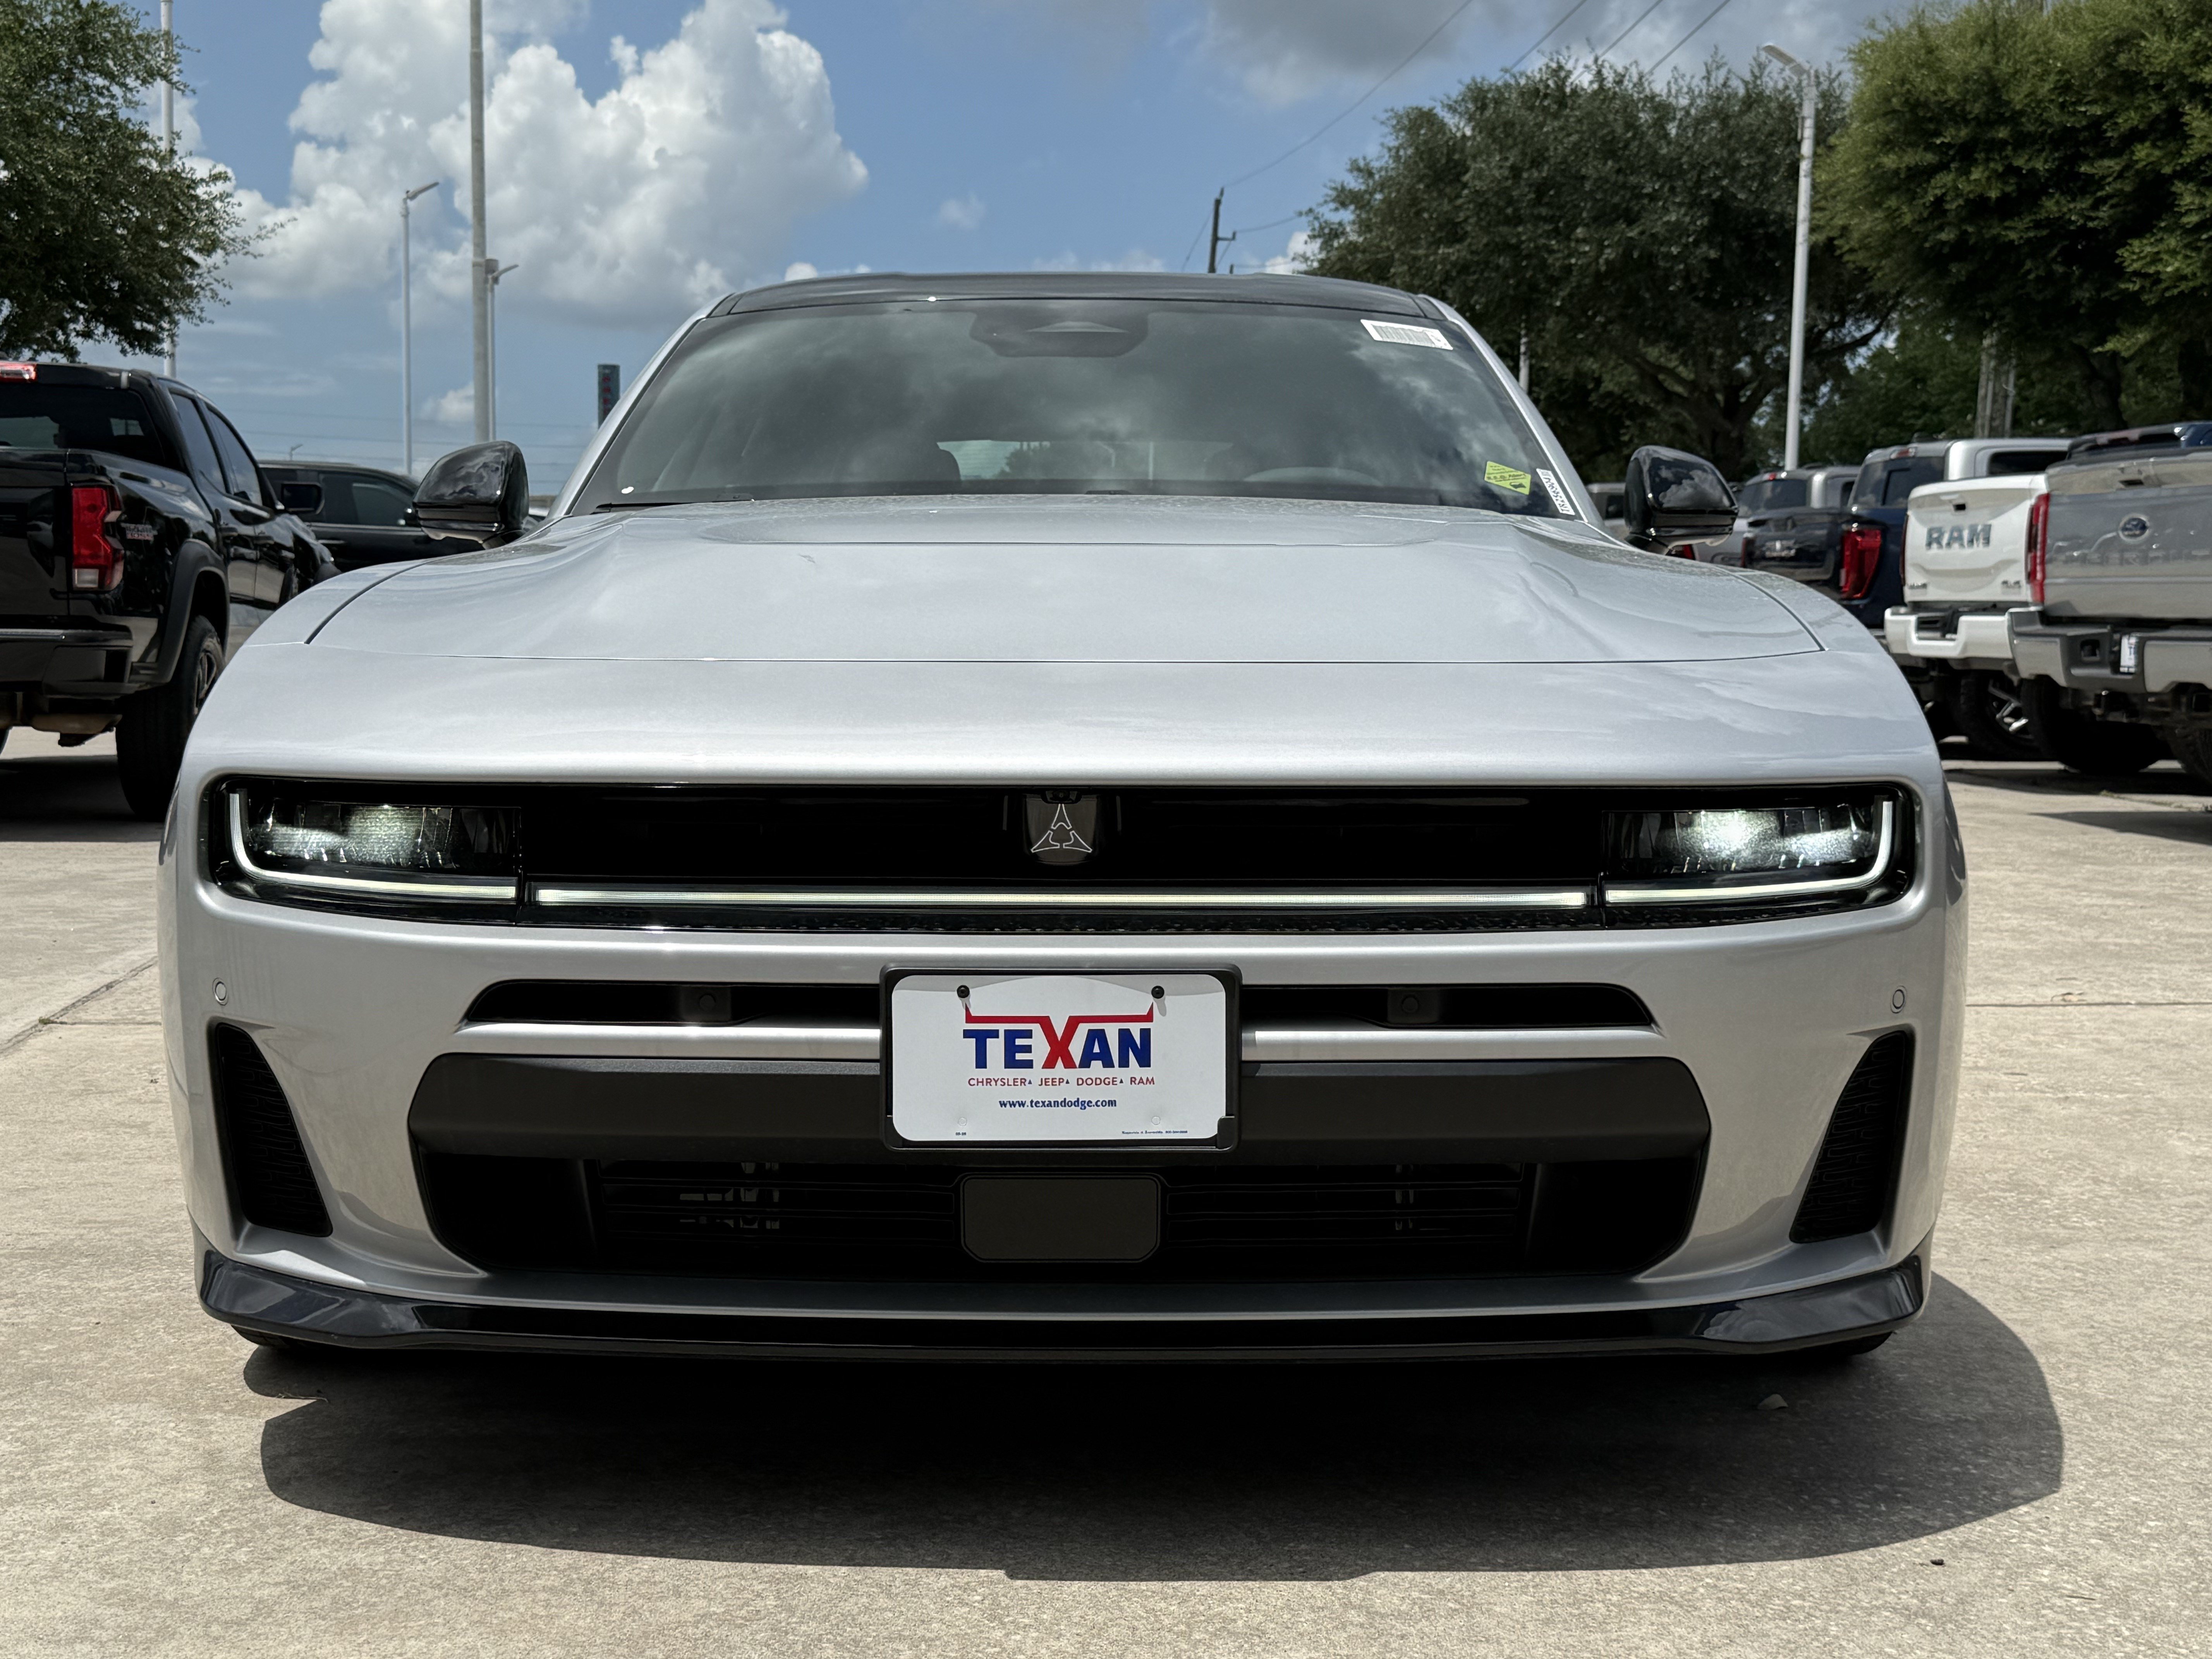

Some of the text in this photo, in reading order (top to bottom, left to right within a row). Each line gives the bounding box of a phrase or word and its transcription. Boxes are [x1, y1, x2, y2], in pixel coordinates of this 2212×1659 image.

[1925, 524, 1992, 550] RAM
[962, 1015, 1152, 1069] TEXAN
[967, 1076, 1155, 1087] CHRYSLER JEEP DODGE RAM
[998, 1097, 1117, 1110] www.texandodge.com
